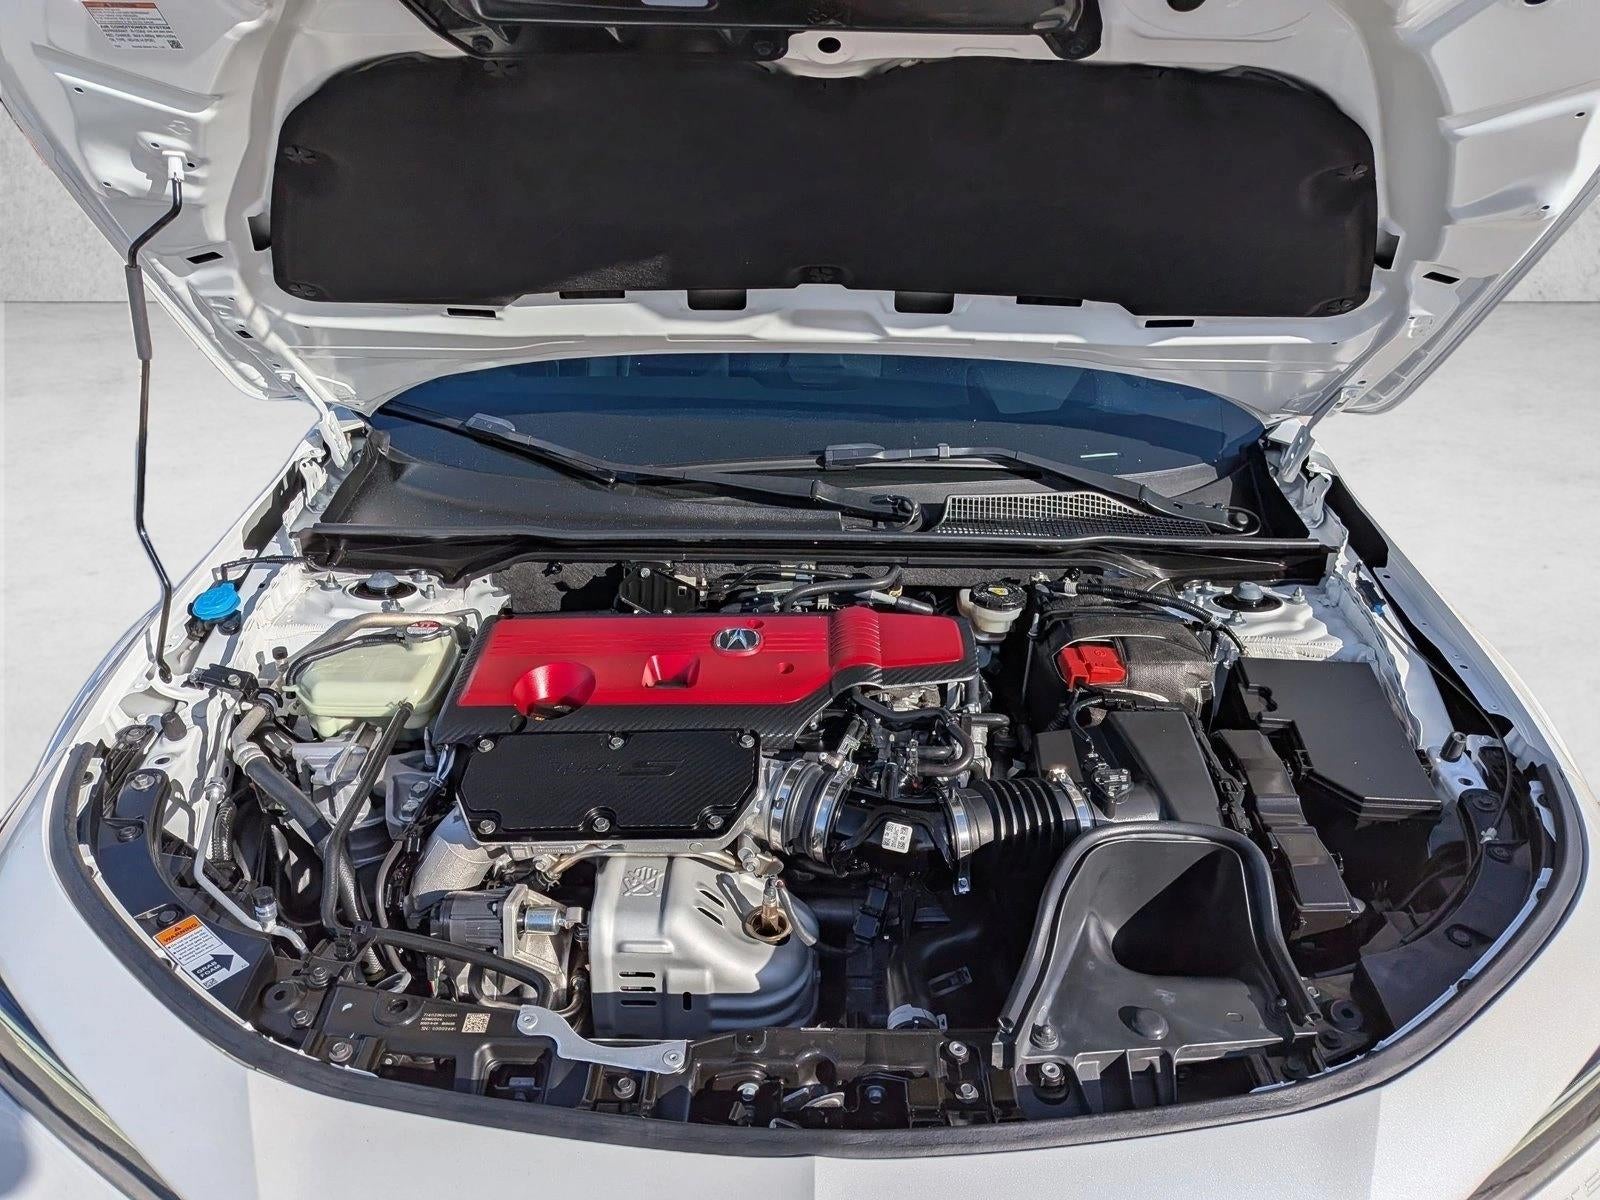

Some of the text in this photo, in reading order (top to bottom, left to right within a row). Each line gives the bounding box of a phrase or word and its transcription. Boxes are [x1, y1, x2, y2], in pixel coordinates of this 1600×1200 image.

[163, 923, 198, 942] WARNING
[196, 960, 218, 974] GRAB
[200, 964, 222, 978] FOAM
